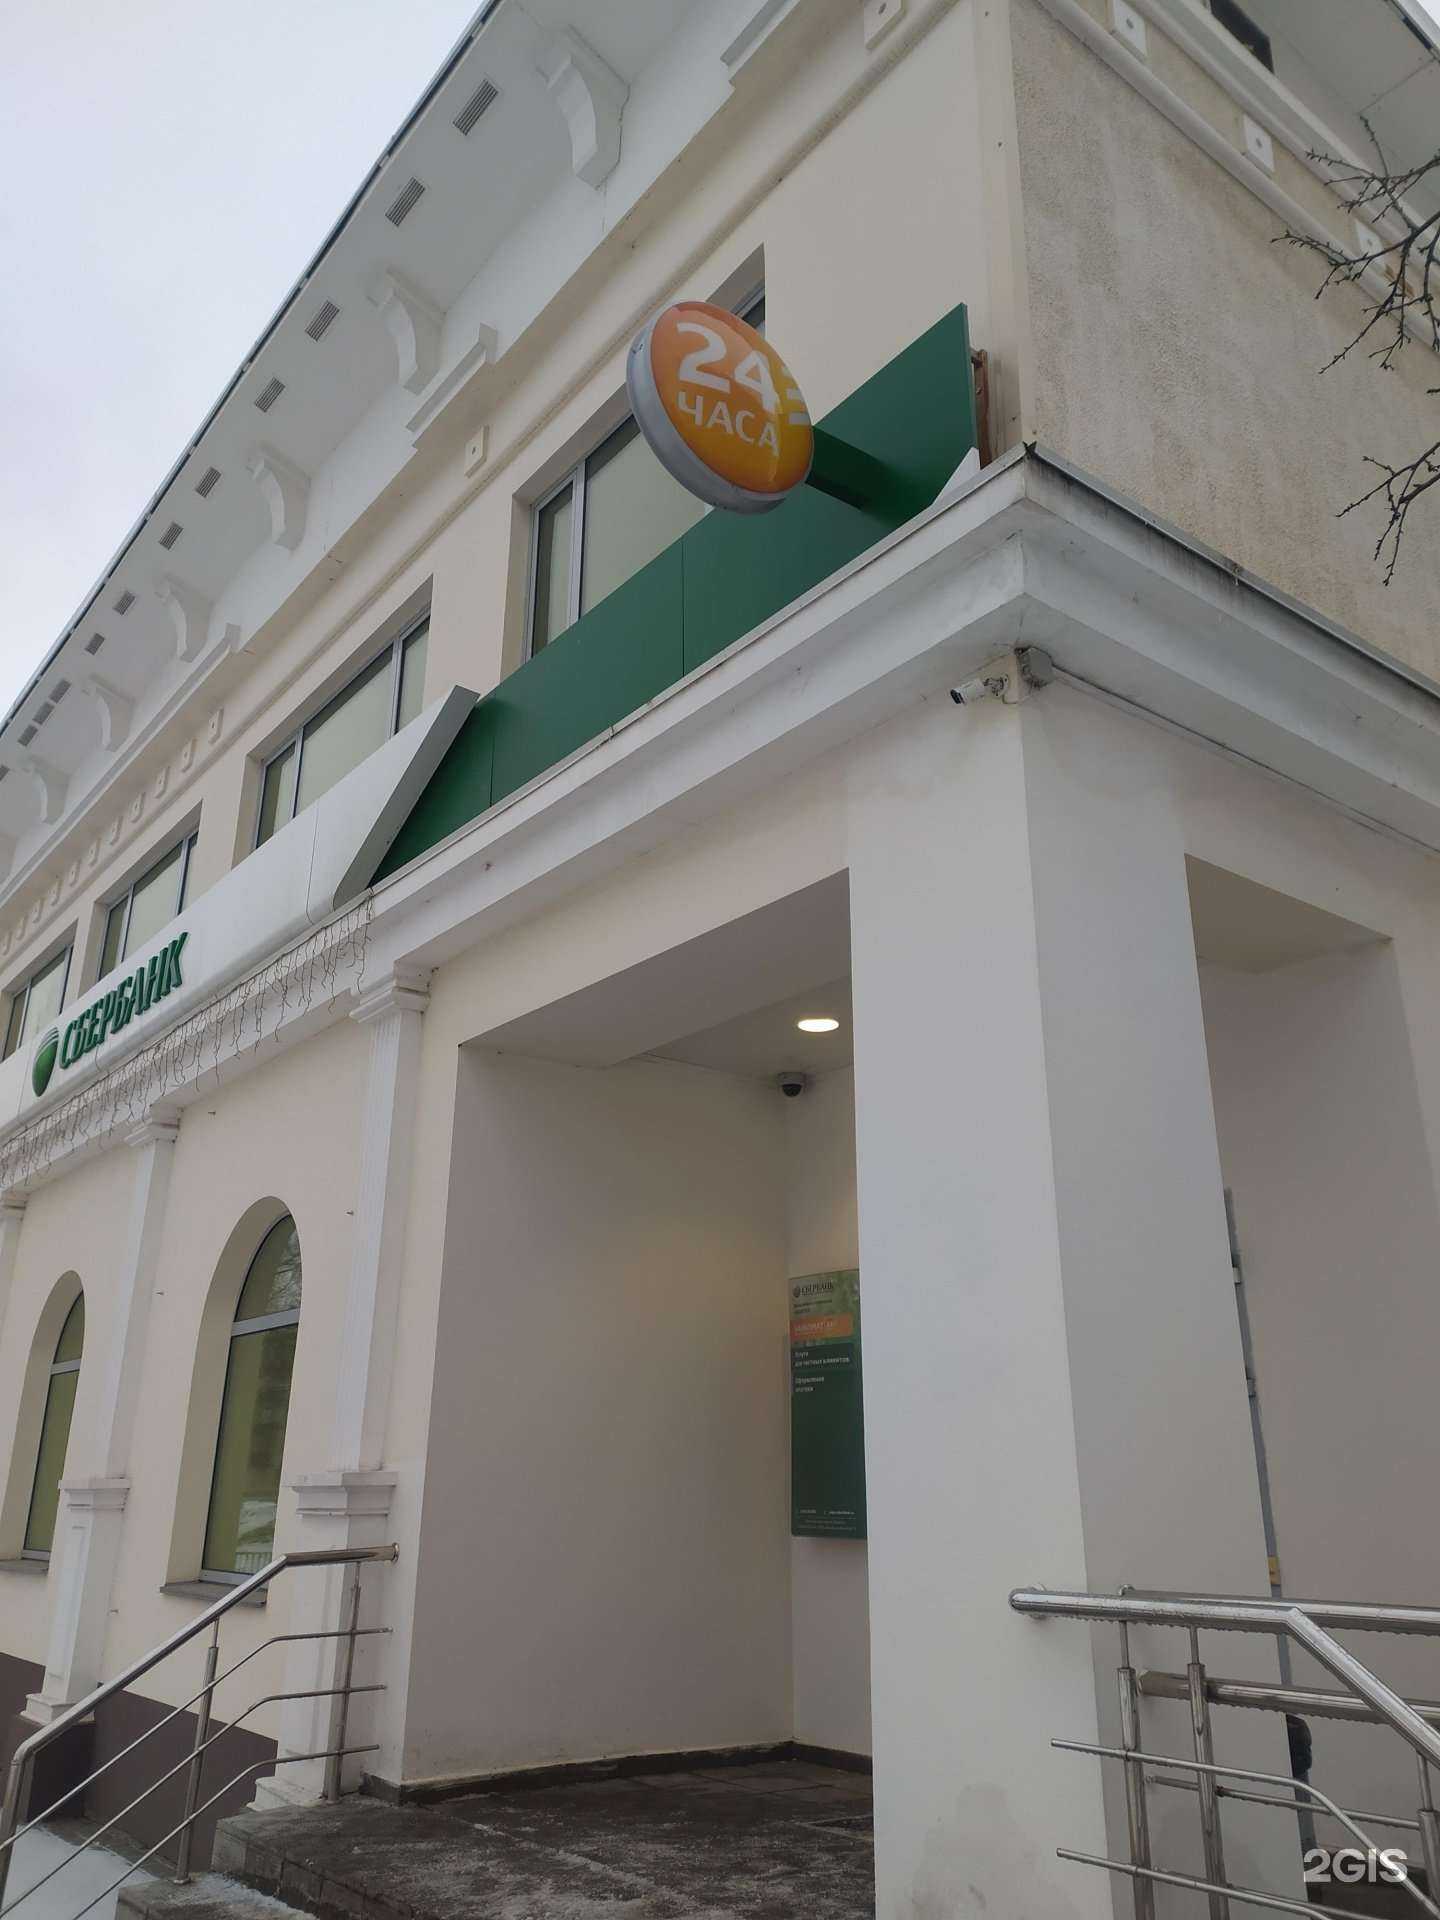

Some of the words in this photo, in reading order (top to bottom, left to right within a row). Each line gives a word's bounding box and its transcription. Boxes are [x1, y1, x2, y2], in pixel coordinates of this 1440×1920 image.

[677, 322, 781, 413] 24
[677, 391, 780, 457] ЧАСА
[59, 931, 189, 1070] СБЕРБАНК
